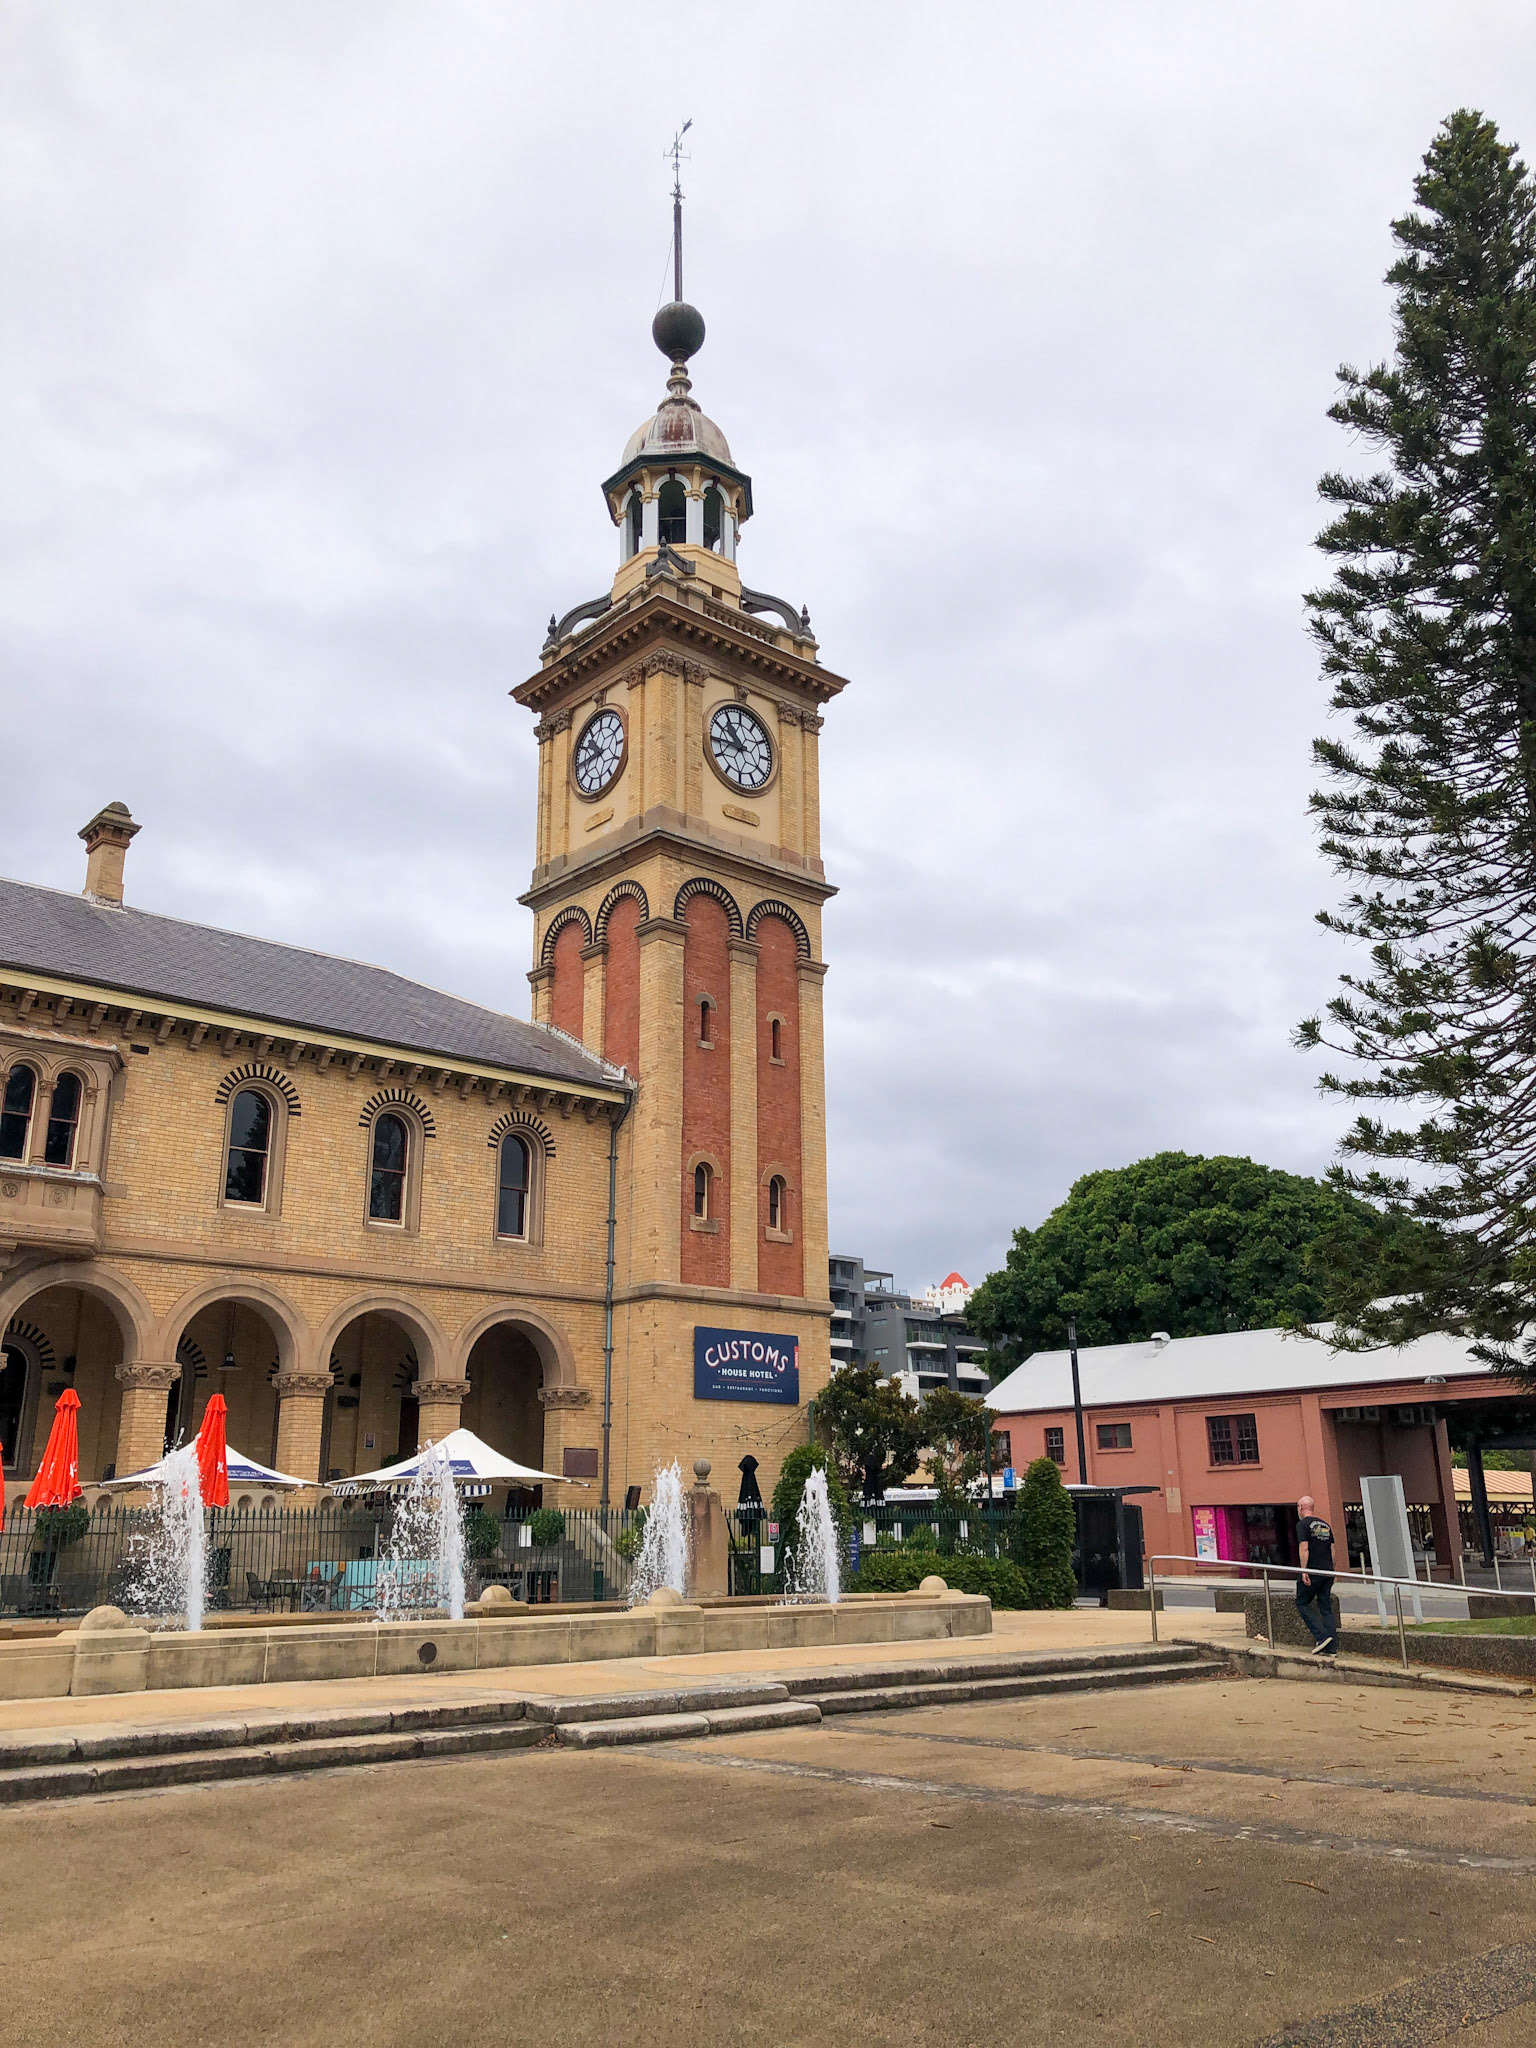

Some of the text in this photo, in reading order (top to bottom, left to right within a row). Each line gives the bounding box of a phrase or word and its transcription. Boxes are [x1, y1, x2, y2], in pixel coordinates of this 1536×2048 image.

[704, 1340, 789, 1373] CUSTOMS
[721, 1368, 774, 1379] HOUSE HOTEL
